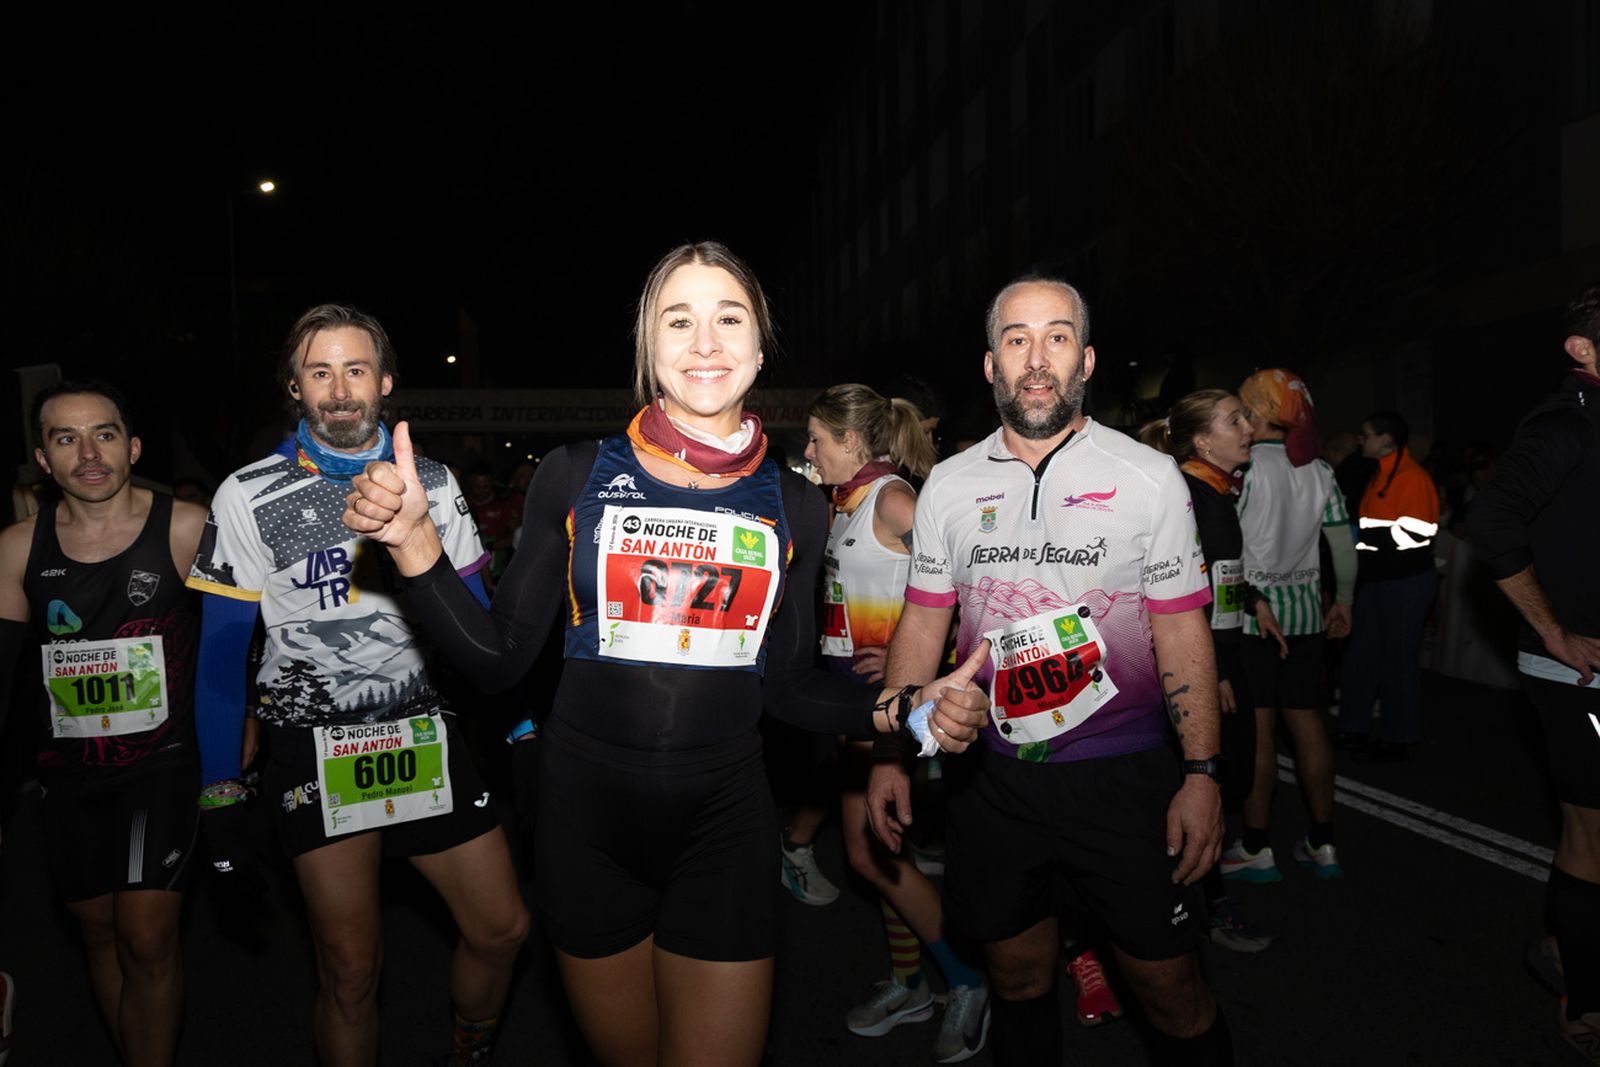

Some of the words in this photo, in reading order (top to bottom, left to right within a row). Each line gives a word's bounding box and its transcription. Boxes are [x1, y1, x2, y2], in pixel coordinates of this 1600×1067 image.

[396, 405, 481, 422] CARRERA
[489, 405, 624, 423] INTERNACION
[623, 519, 640, 529] 43
[643, 523, 696, 539] NOCHE
[698, 528, 718, 542] DE
[621, 538, 656, 555] SAN
[659, 542, 717, 561] ANTÓN
[967, 545, 1019, 568] SIERRA
[1022, 548, 1037, 560] DE
[1035, 542, 1100, 566] SEGURA
[66, 652, 101, 664] NOCHE
[103, 651, 117, 661] DE
[55, 665, 76, 677] SAN
[79, 661, 118, 676] ANTÓN
[71, 672, 136, 706] 1011
[348, 726, 386, 740] NOCHE
[387, 724, 401, 735] DE
[333, 743, 359, 757] SAN
[361, 735, 403, 753] ANTÓN
[354, 749, 417, 790] 600
[361, 790, 384, 800] Pedro
[385, 784, 413, 796] Manuel
